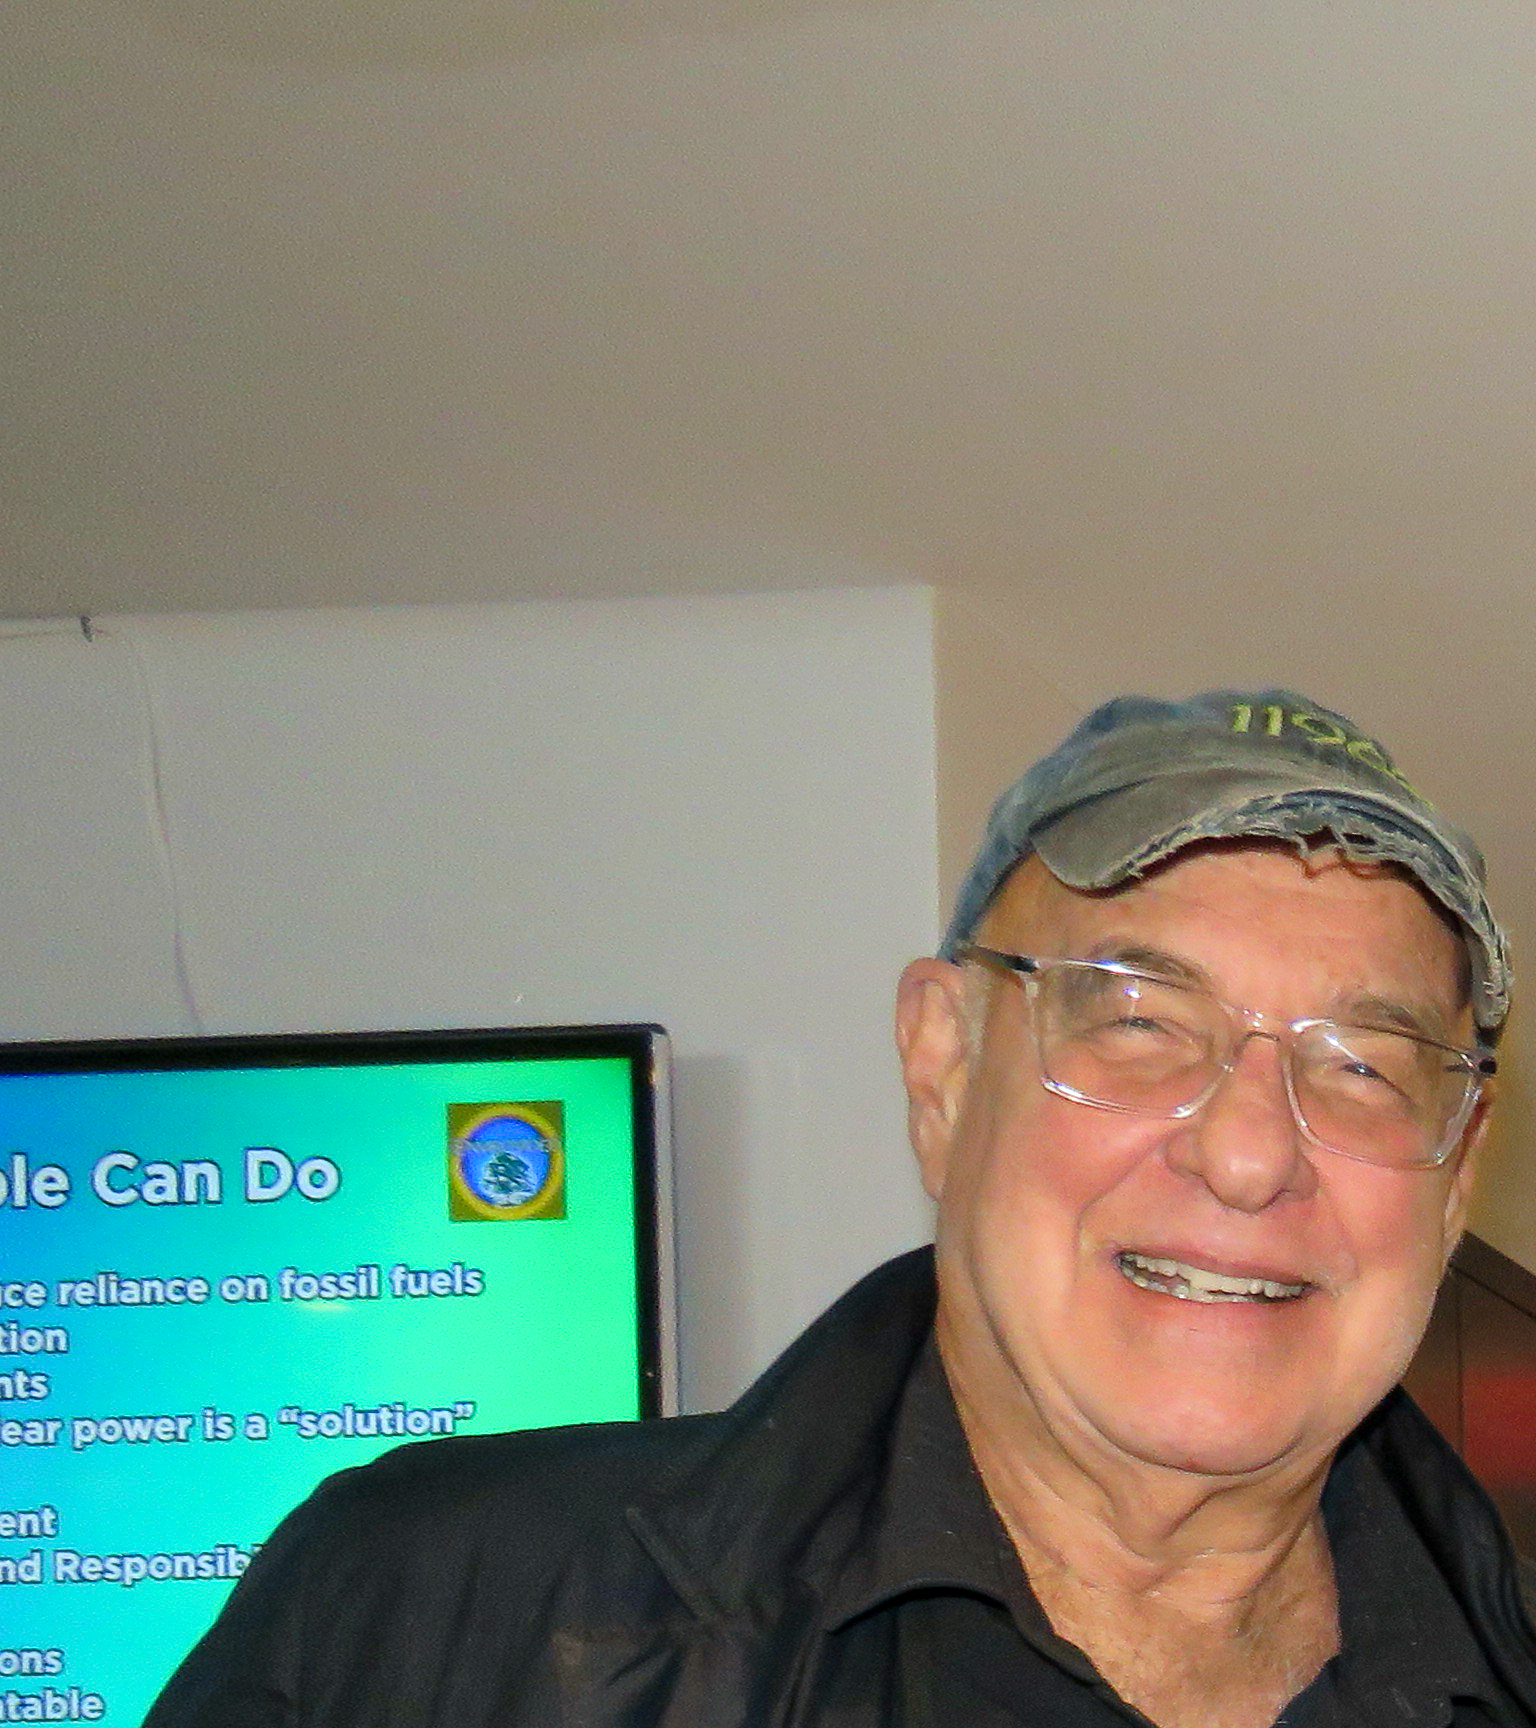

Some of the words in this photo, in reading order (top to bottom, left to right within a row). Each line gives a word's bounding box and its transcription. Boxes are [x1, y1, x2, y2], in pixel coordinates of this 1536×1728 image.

[92, 1149, 222, 1207] Can
[244, 1147, 342, 1204] Do
[0, 1277, 48, 1309] ce
[58, 1271, 211, 1307] reliance
[220, 1273, 270, 1303] on
[279, 1264, 382, 1301] fossil
[389, 1261, 486, 1298] fuels
[0, 1418, 63, 1448] ear
[73, 1415, 194, 1451] power
[203, 1407, 237, 1441] is
[243, 1413, 269, 1441] a
[278, 1401, 477, 1440] “solution”
[0, 1505, 59, 1539] ent
[54, 1543, 264, 1587] Responsib
[0, 1647, 65, 1677] ons
[0, 1686, 106, 1724] table
